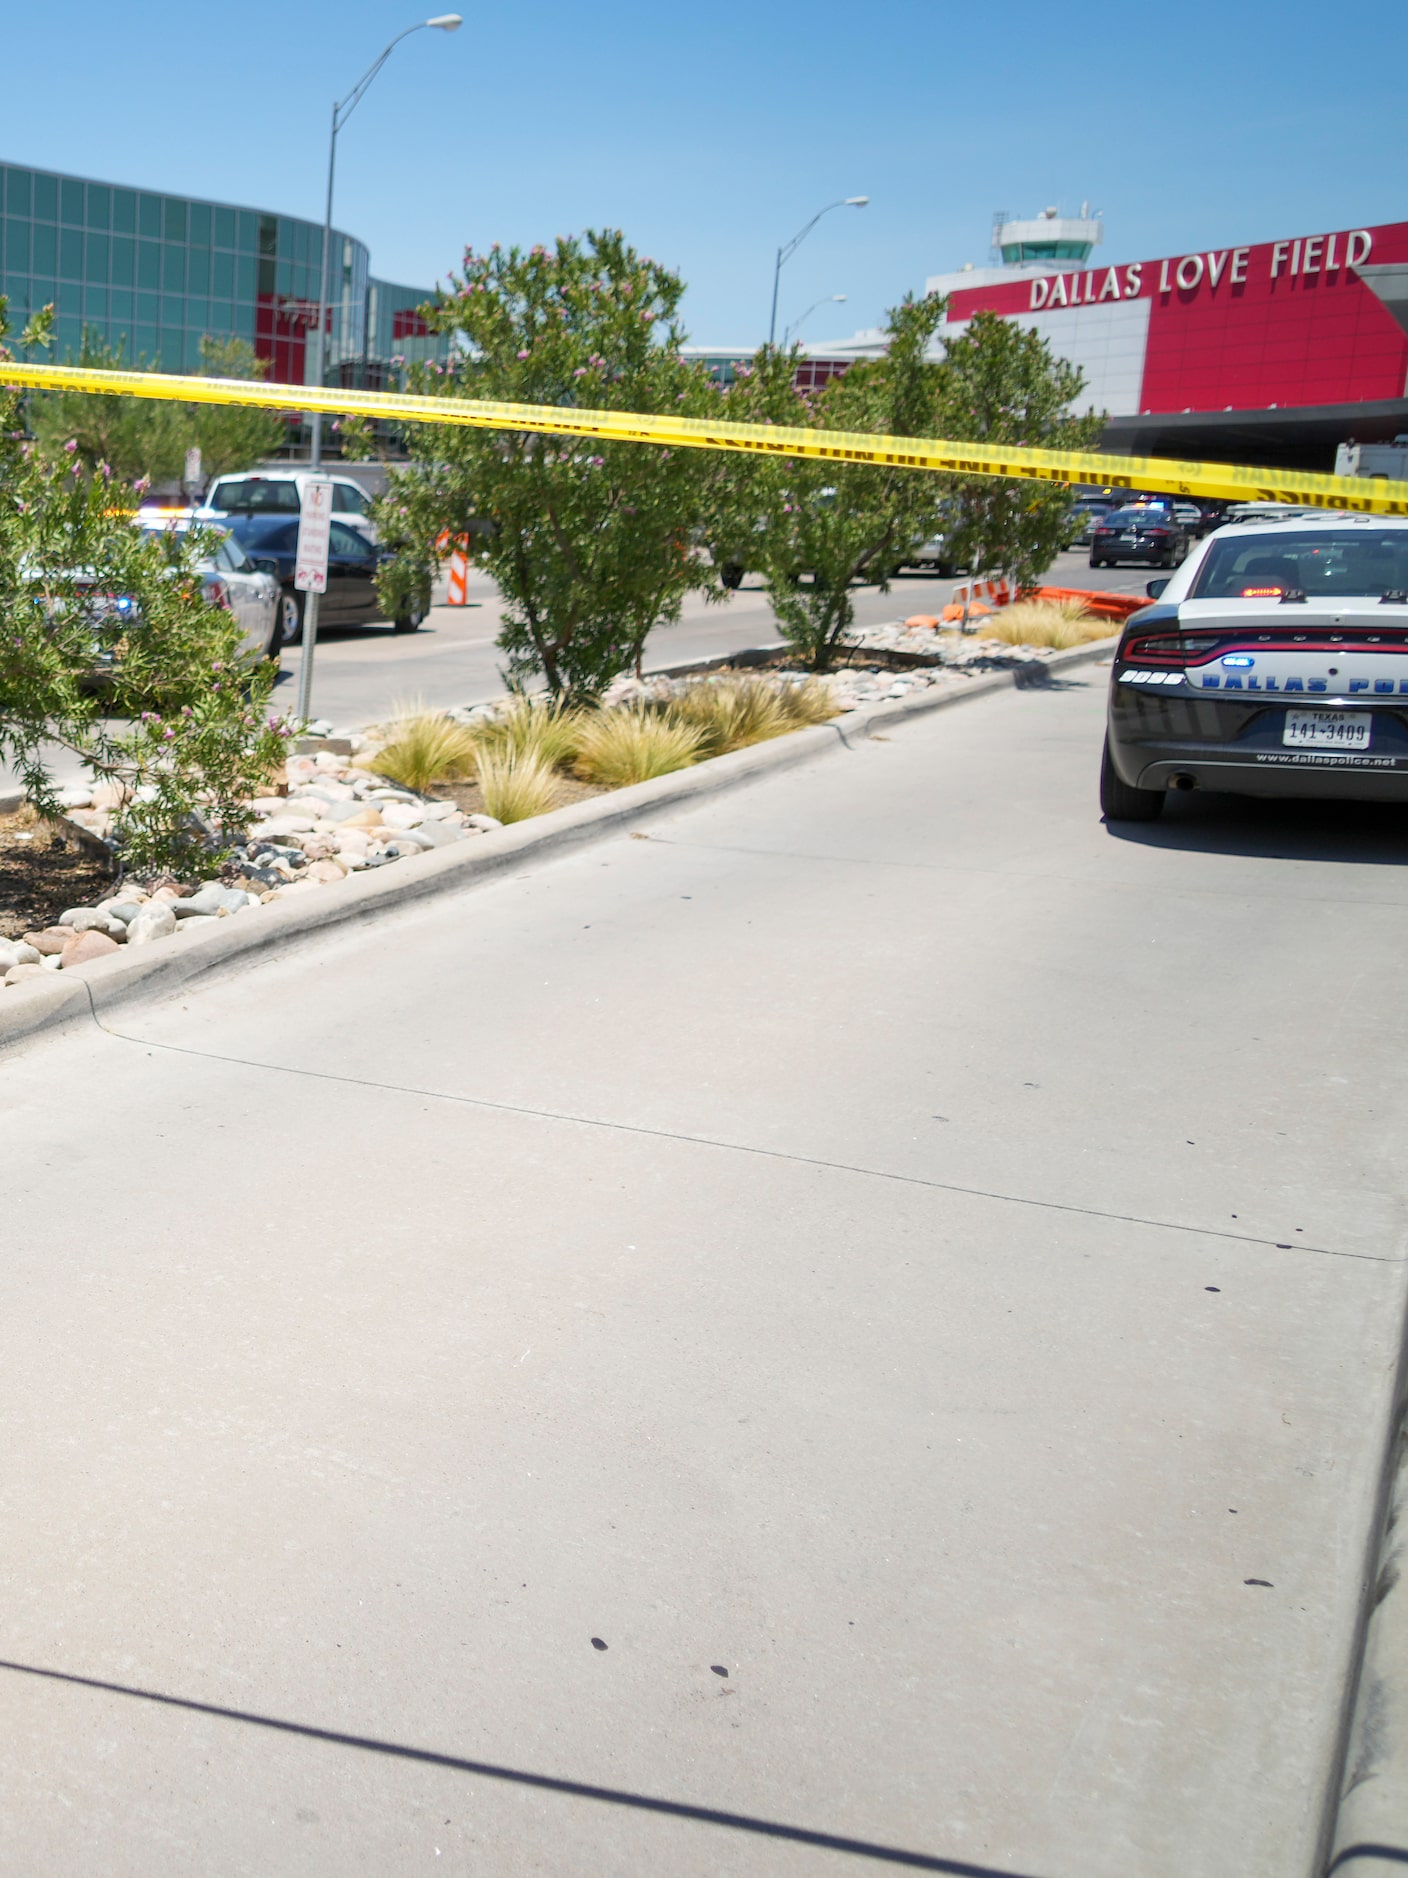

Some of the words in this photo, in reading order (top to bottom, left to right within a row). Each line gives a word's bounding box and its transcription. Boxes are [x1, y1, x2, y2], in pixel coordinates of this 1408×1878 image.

[1029, 263, 1143, 310] DALLAS
[1159, 247, 1251, 294] LOVE
[1270, 229, 1374, 279] FIELD
[1202, 673, 1328, 693] DALLAS
[1312, 712, 1345, 721] TEXAS
[1256, 753, 1396, 767] www.dallaspolice.net
